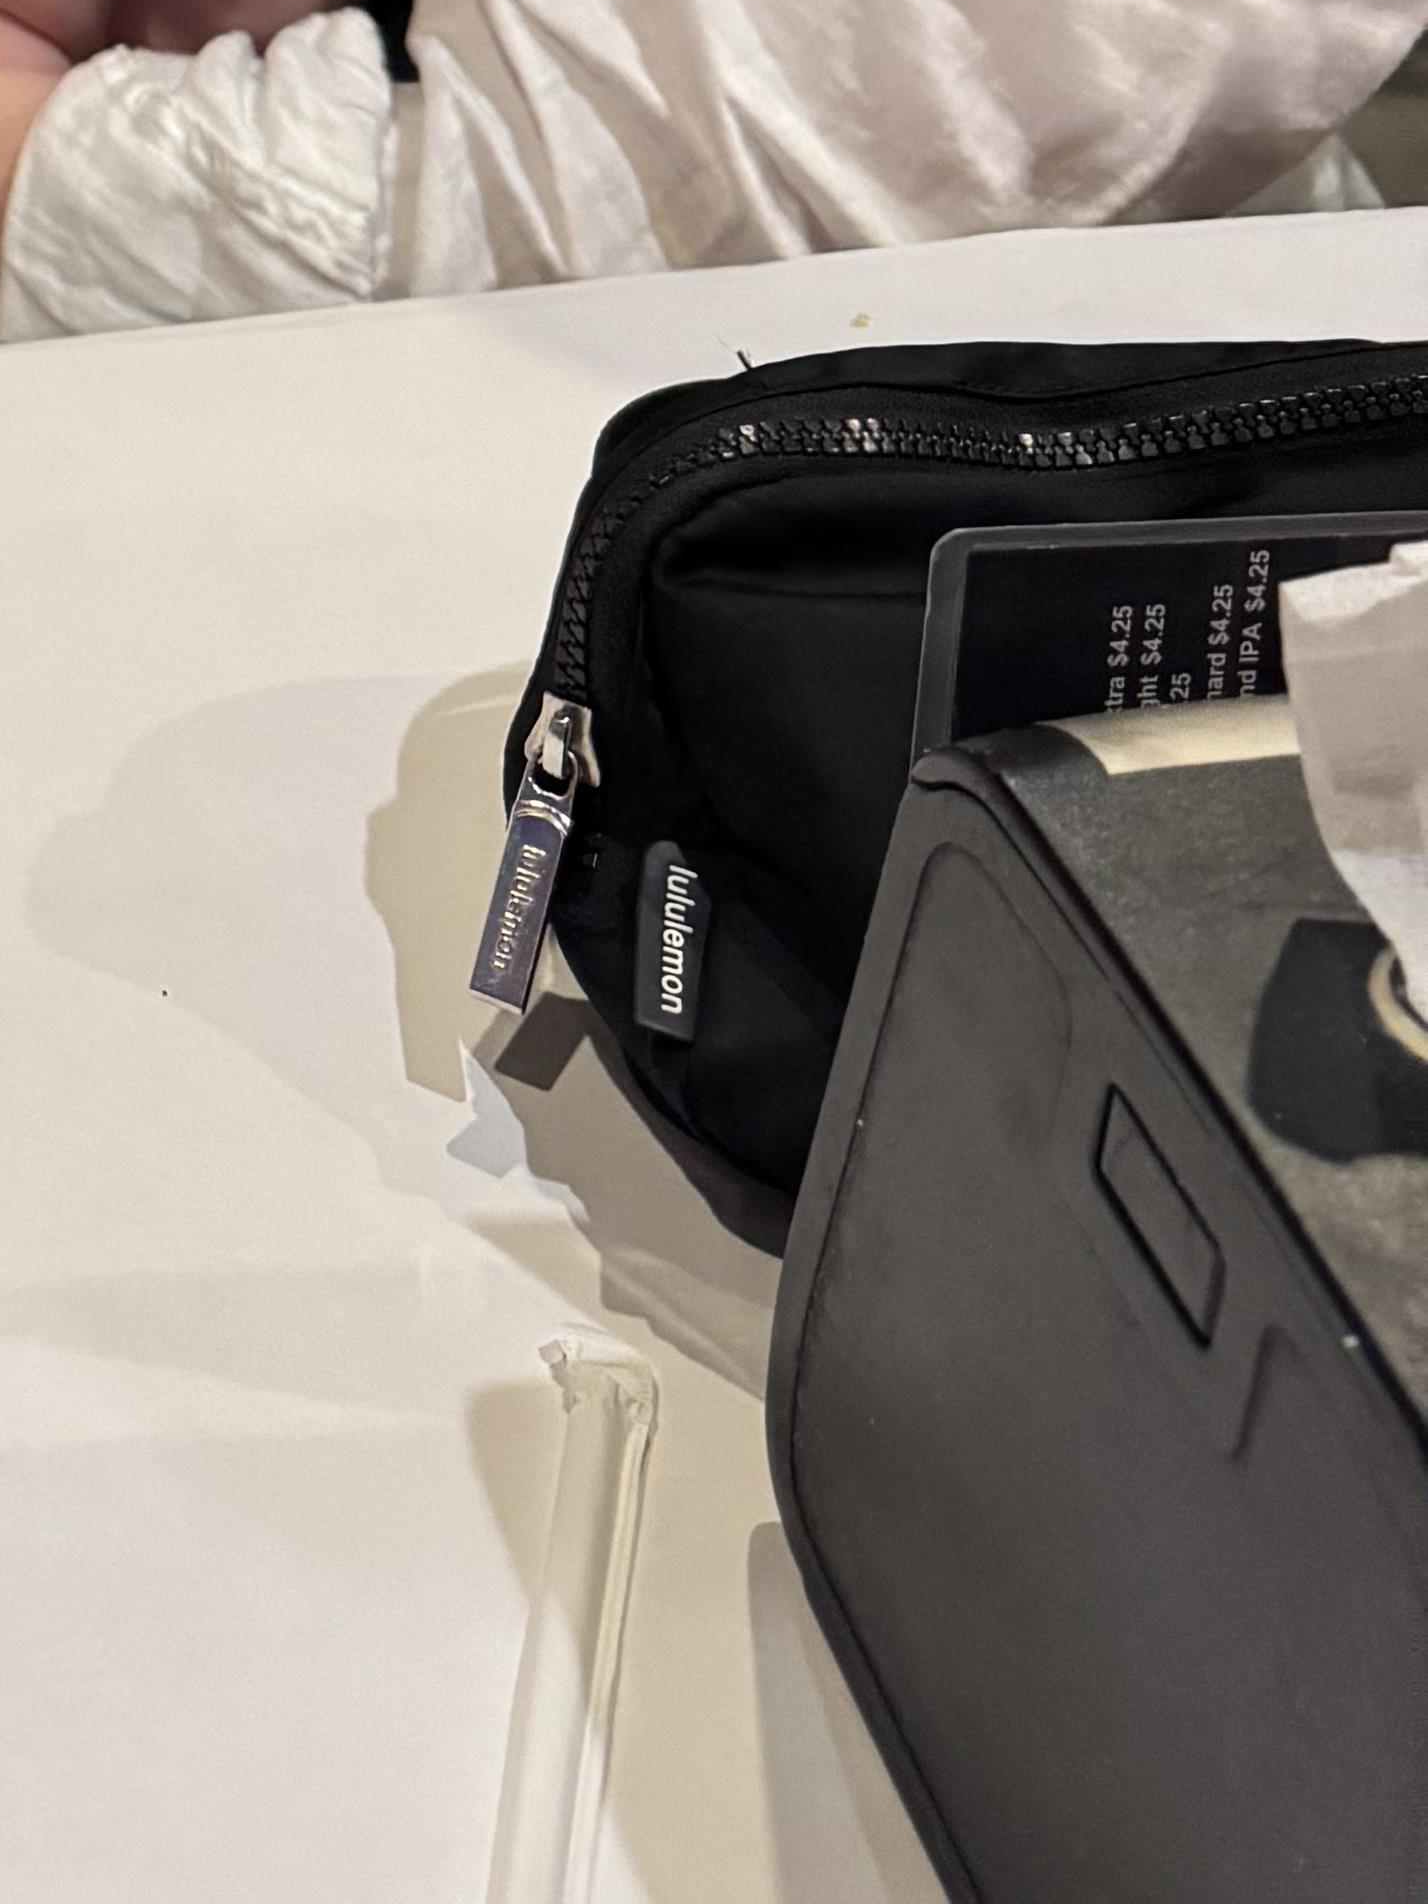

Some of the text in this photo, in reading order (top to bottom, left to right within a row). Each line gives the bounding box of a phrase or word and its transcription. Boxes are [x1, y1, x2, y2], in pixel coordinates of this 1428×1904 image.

[1244, 550, 1270, 612] $4.25
[1107, 605, 1133, 668] $4.25
[1140, 603, 1166, 665] $4.25
[1207, 584, 1234, 646] $4.25
[1239, 622, 1263, 663] IPA
[1170, 672, 1192, 703] 25
[660, 864, 698, 1015] lululemon
